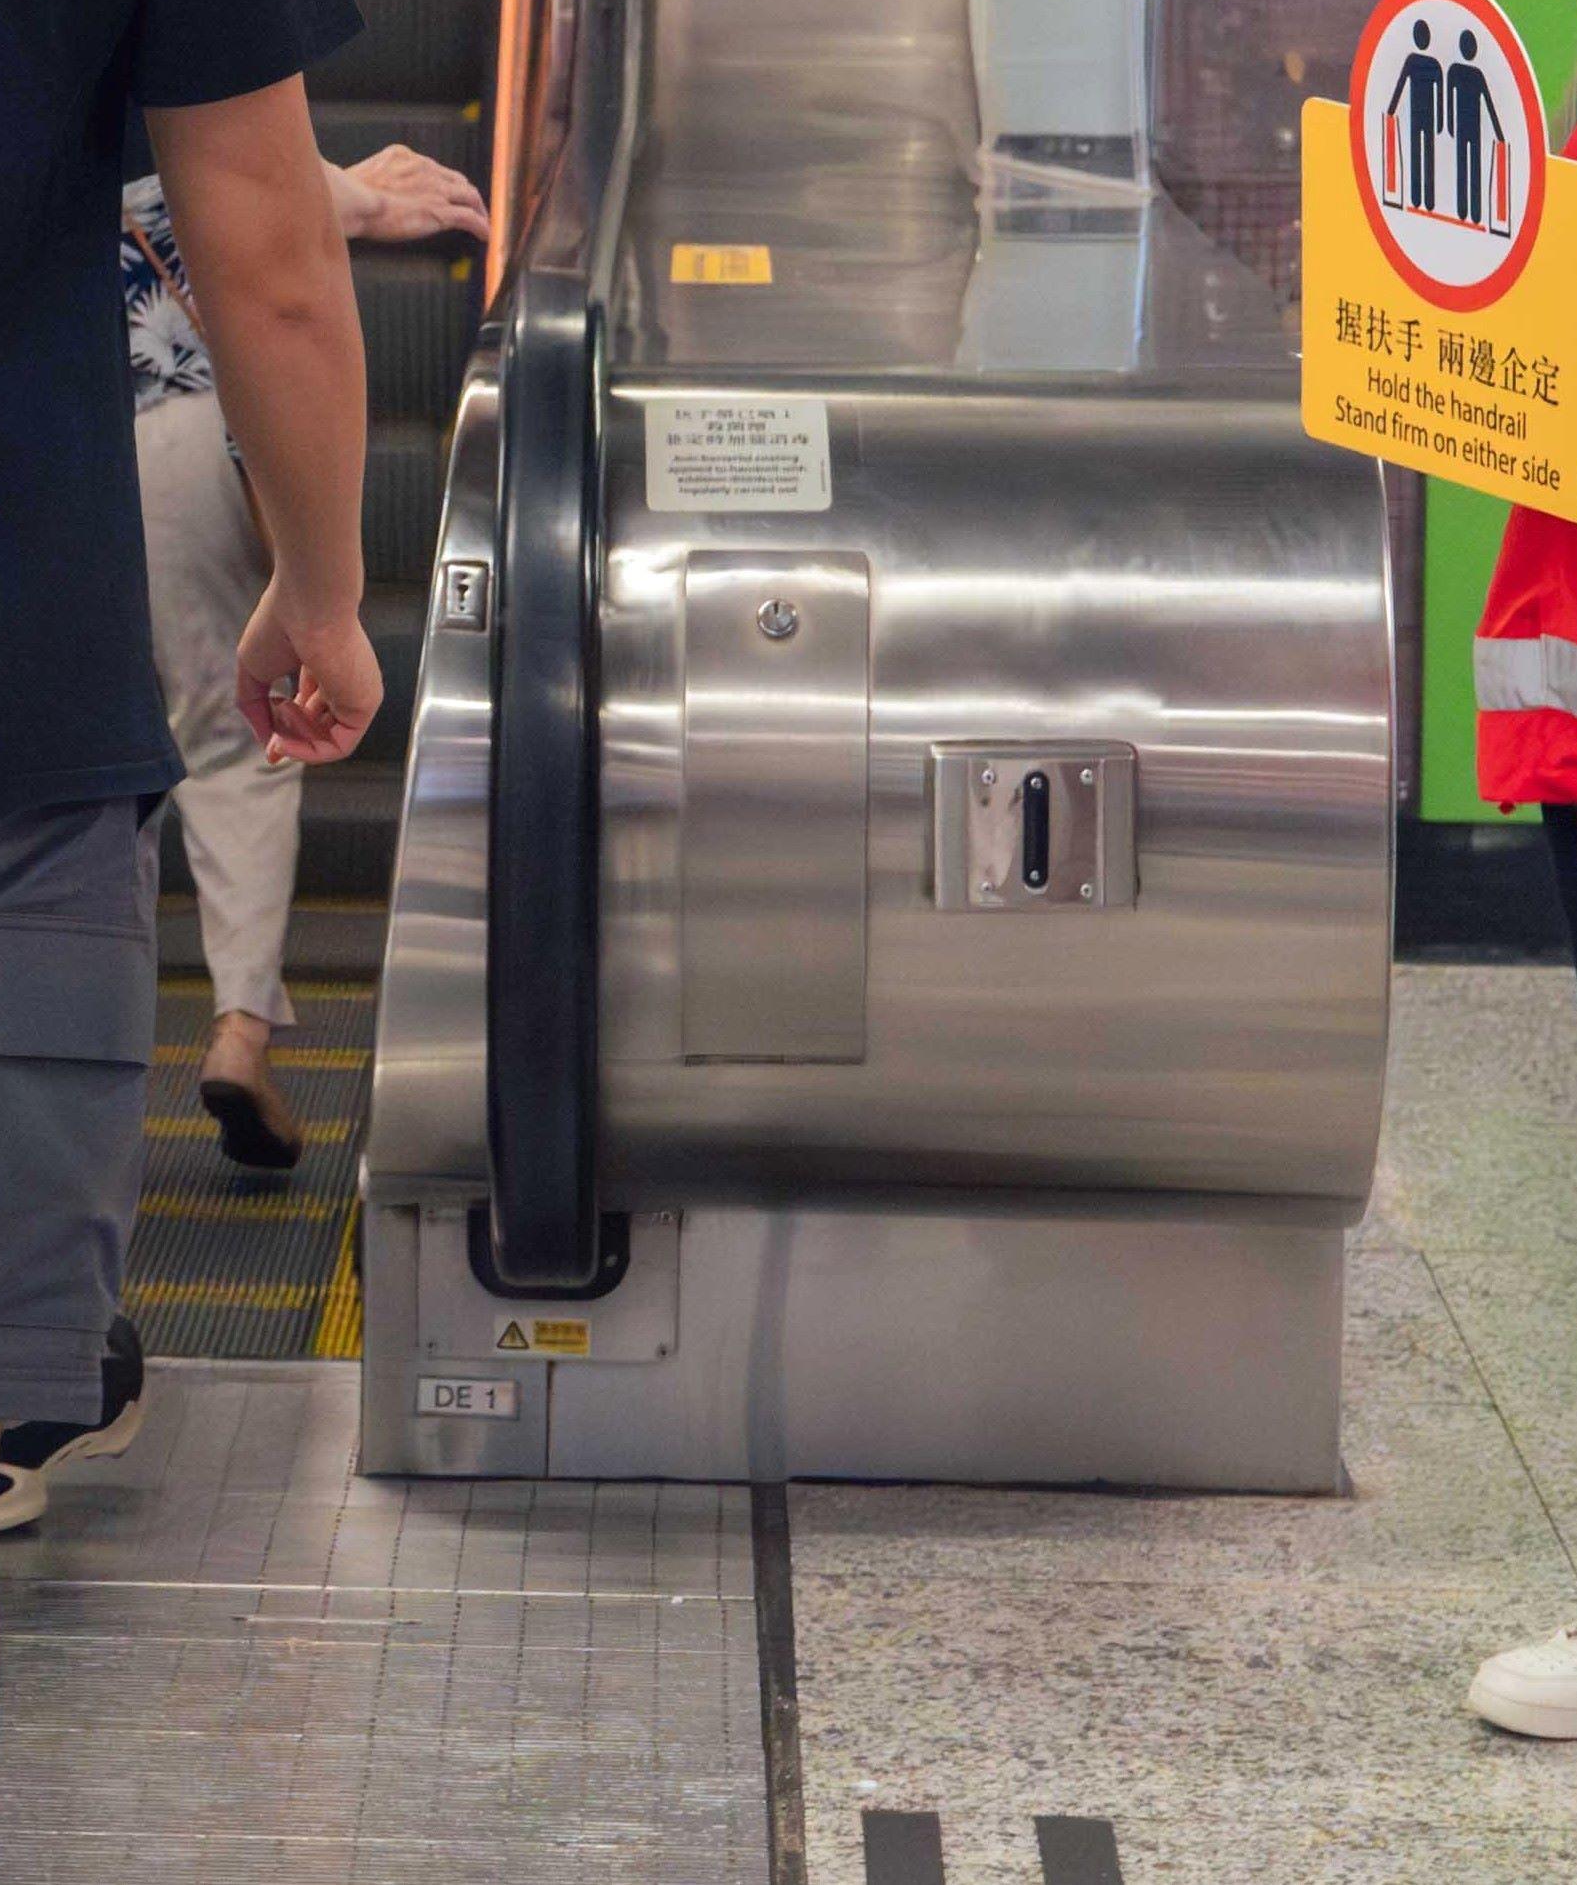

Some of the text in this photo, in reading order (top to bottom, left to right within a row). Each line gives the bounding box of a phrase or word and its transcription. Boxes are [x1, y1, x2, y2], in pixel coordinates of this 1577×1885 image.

[1335, 297, 1560, 407] 握扶手 兩邊企定
[1335, 394, 1561, 491] Stand firm on either side
[1368, 367, 1526, 441] Hold the handrail
[433, 1384, 496, 1410] DE 1
